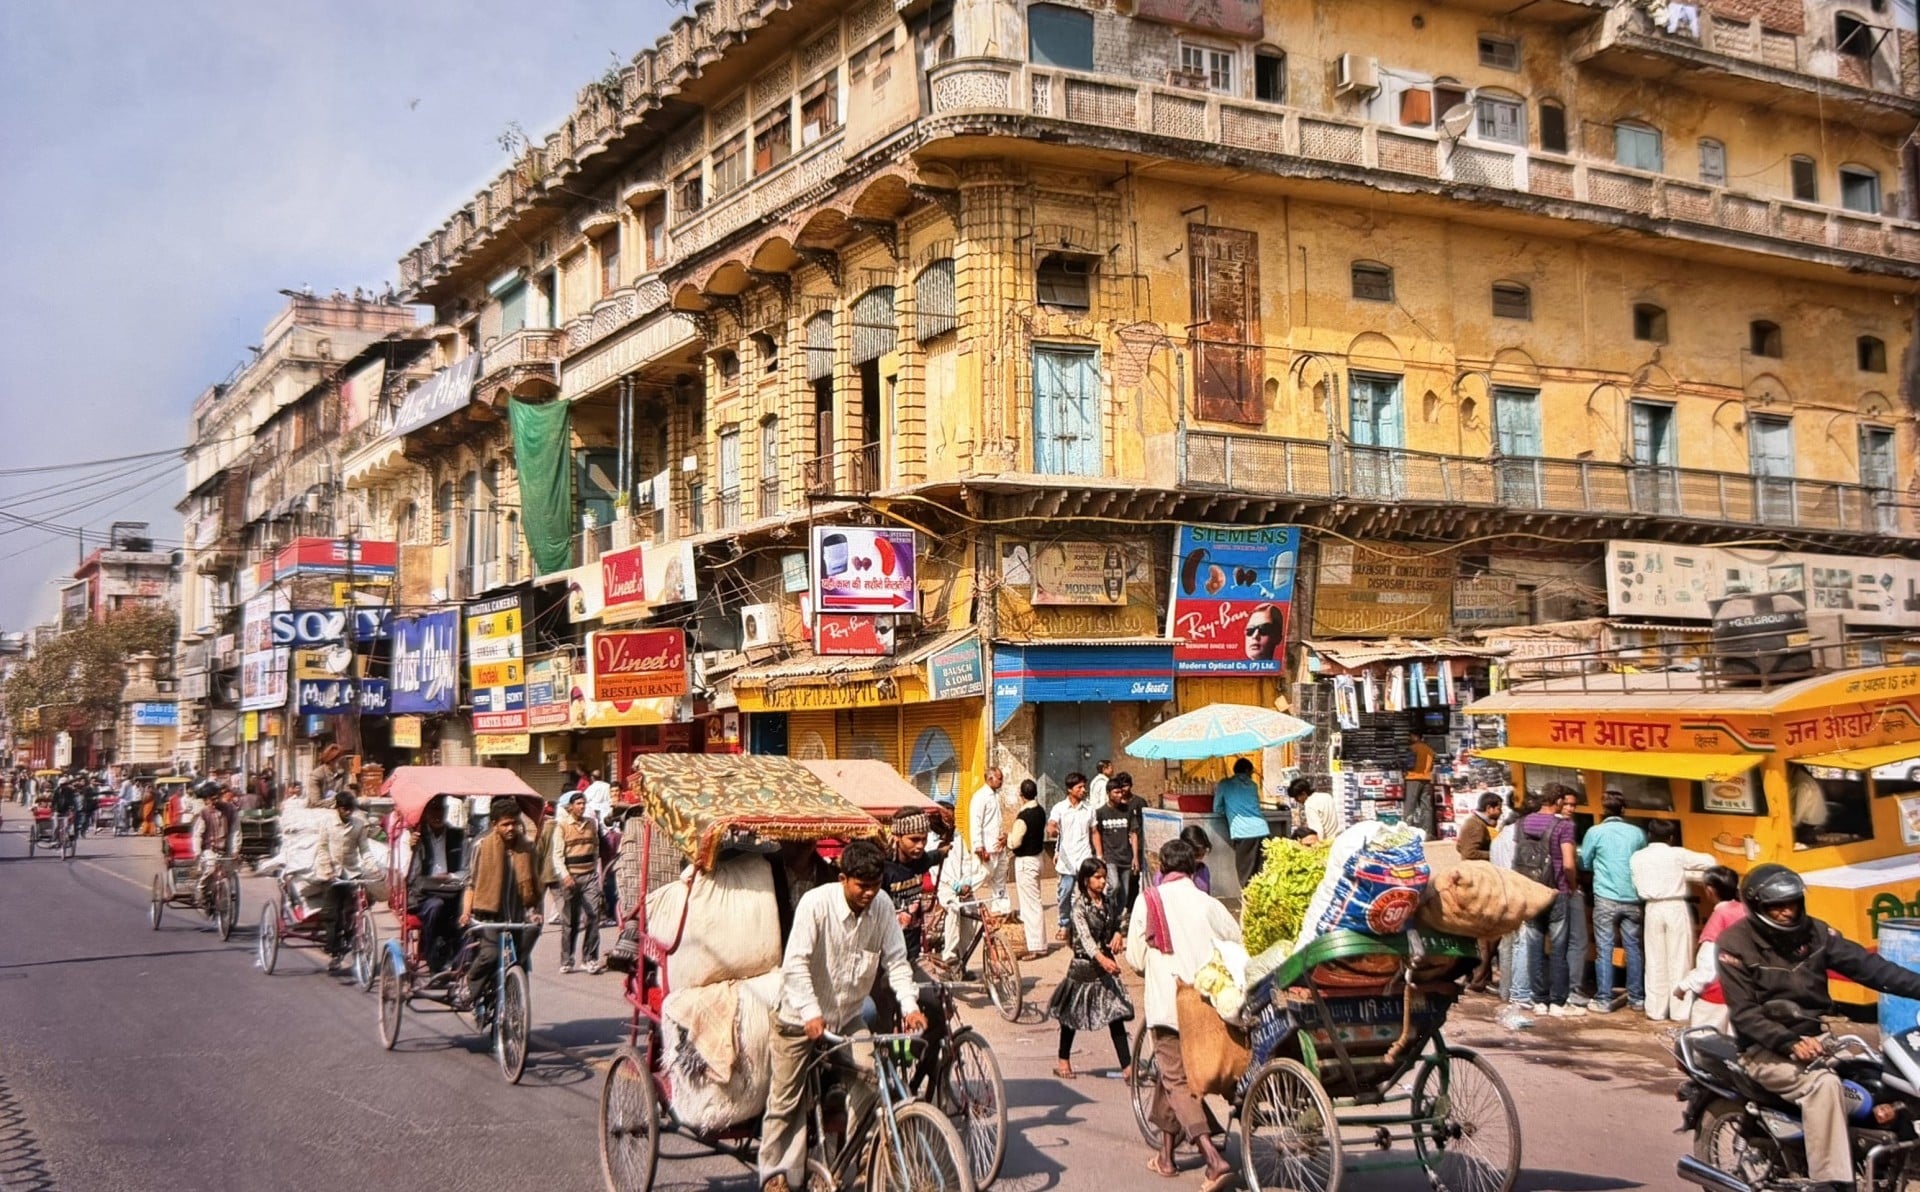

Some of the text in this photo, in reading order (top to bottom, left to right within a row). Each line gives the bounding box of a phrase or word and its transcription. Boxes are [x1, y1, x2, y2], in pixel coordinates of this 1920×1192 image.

[1192, 527, 1289, 545] SIEMENS
[603, 558, 643, 599] Vineet's
[1065, 584, 1104, 594] MODERN
[598, 635, 682, 673] Vineet's
[1178, 661, 1207, 669] Modern
[1208, 661, 1234, 671] Optical
[601, 682, 682, 698] RESTAURANT
[1131, 681, 1144, 695] She
[1549, 719, 1672, 751] जन आहार
[1784, 710, 1875, 746] जन आहार
[1359, 998, 1378, 1019] 119
